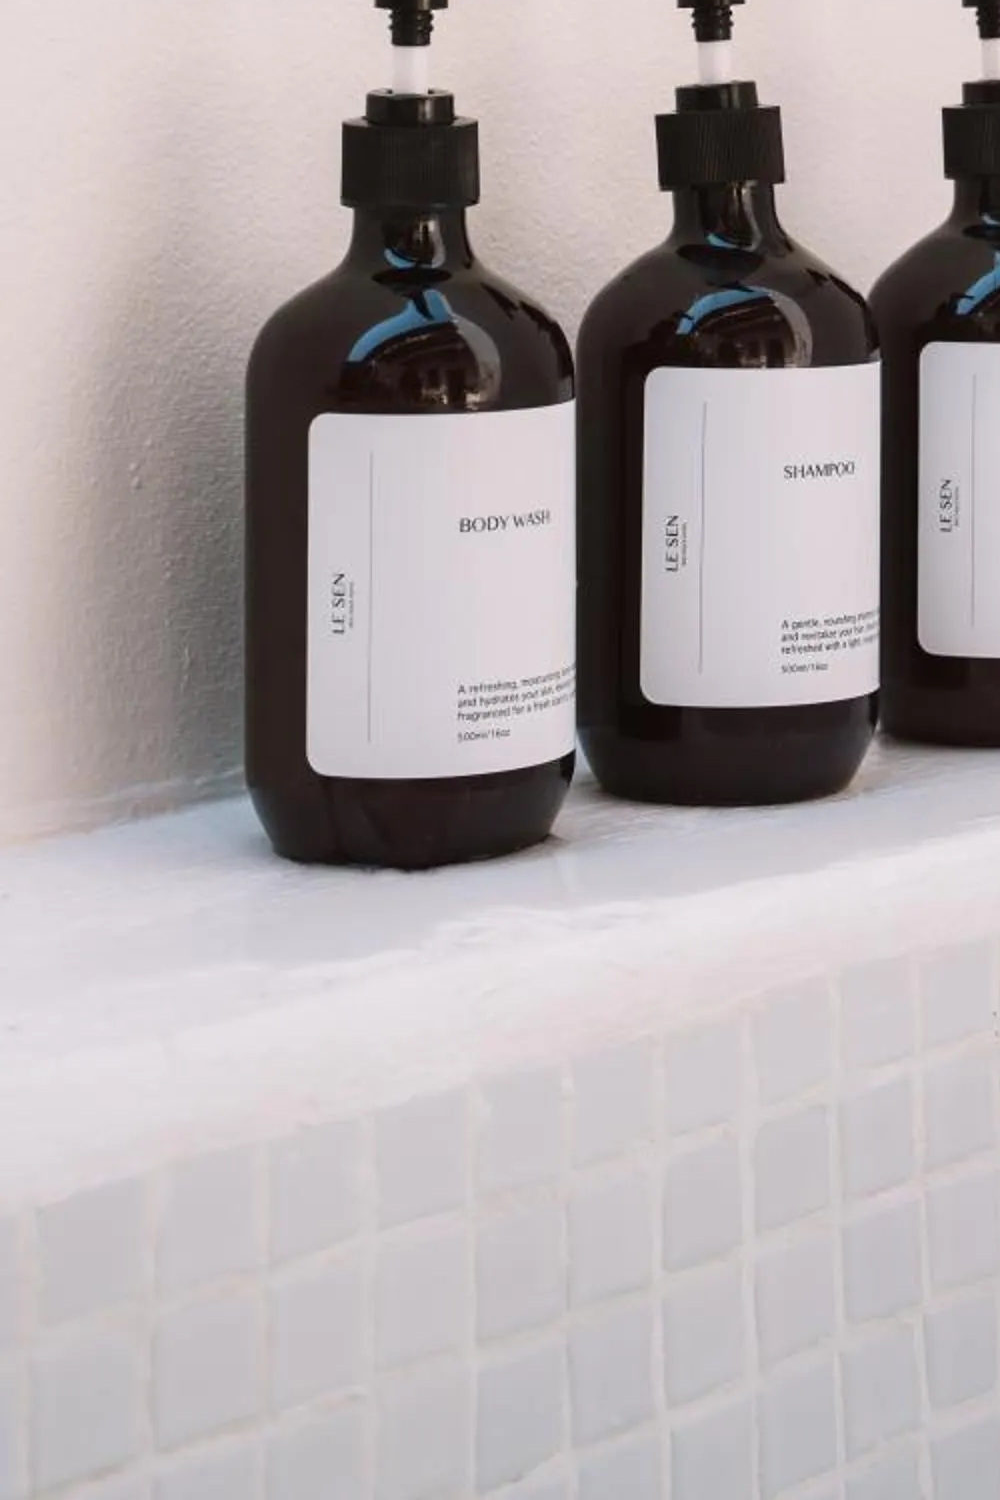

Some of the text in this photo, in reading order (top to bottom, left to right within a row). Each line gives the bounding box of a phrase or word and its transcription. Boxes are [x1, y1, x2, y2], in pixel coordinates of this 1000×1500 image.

[783, 461, 855, 479] SHAMPOO
[939, 479, 952, 533] LE SEN
[459, 508, 550, 533] BODY WASH
[665, 515, 679, 572] LE SEN
[331, 573, 345, 635] LE SEN
[782, 619, 789, 630] A
[782, 632, 799, 642] and
[458, 684, 466, 694] A
[458, 698, 477, 709] and
